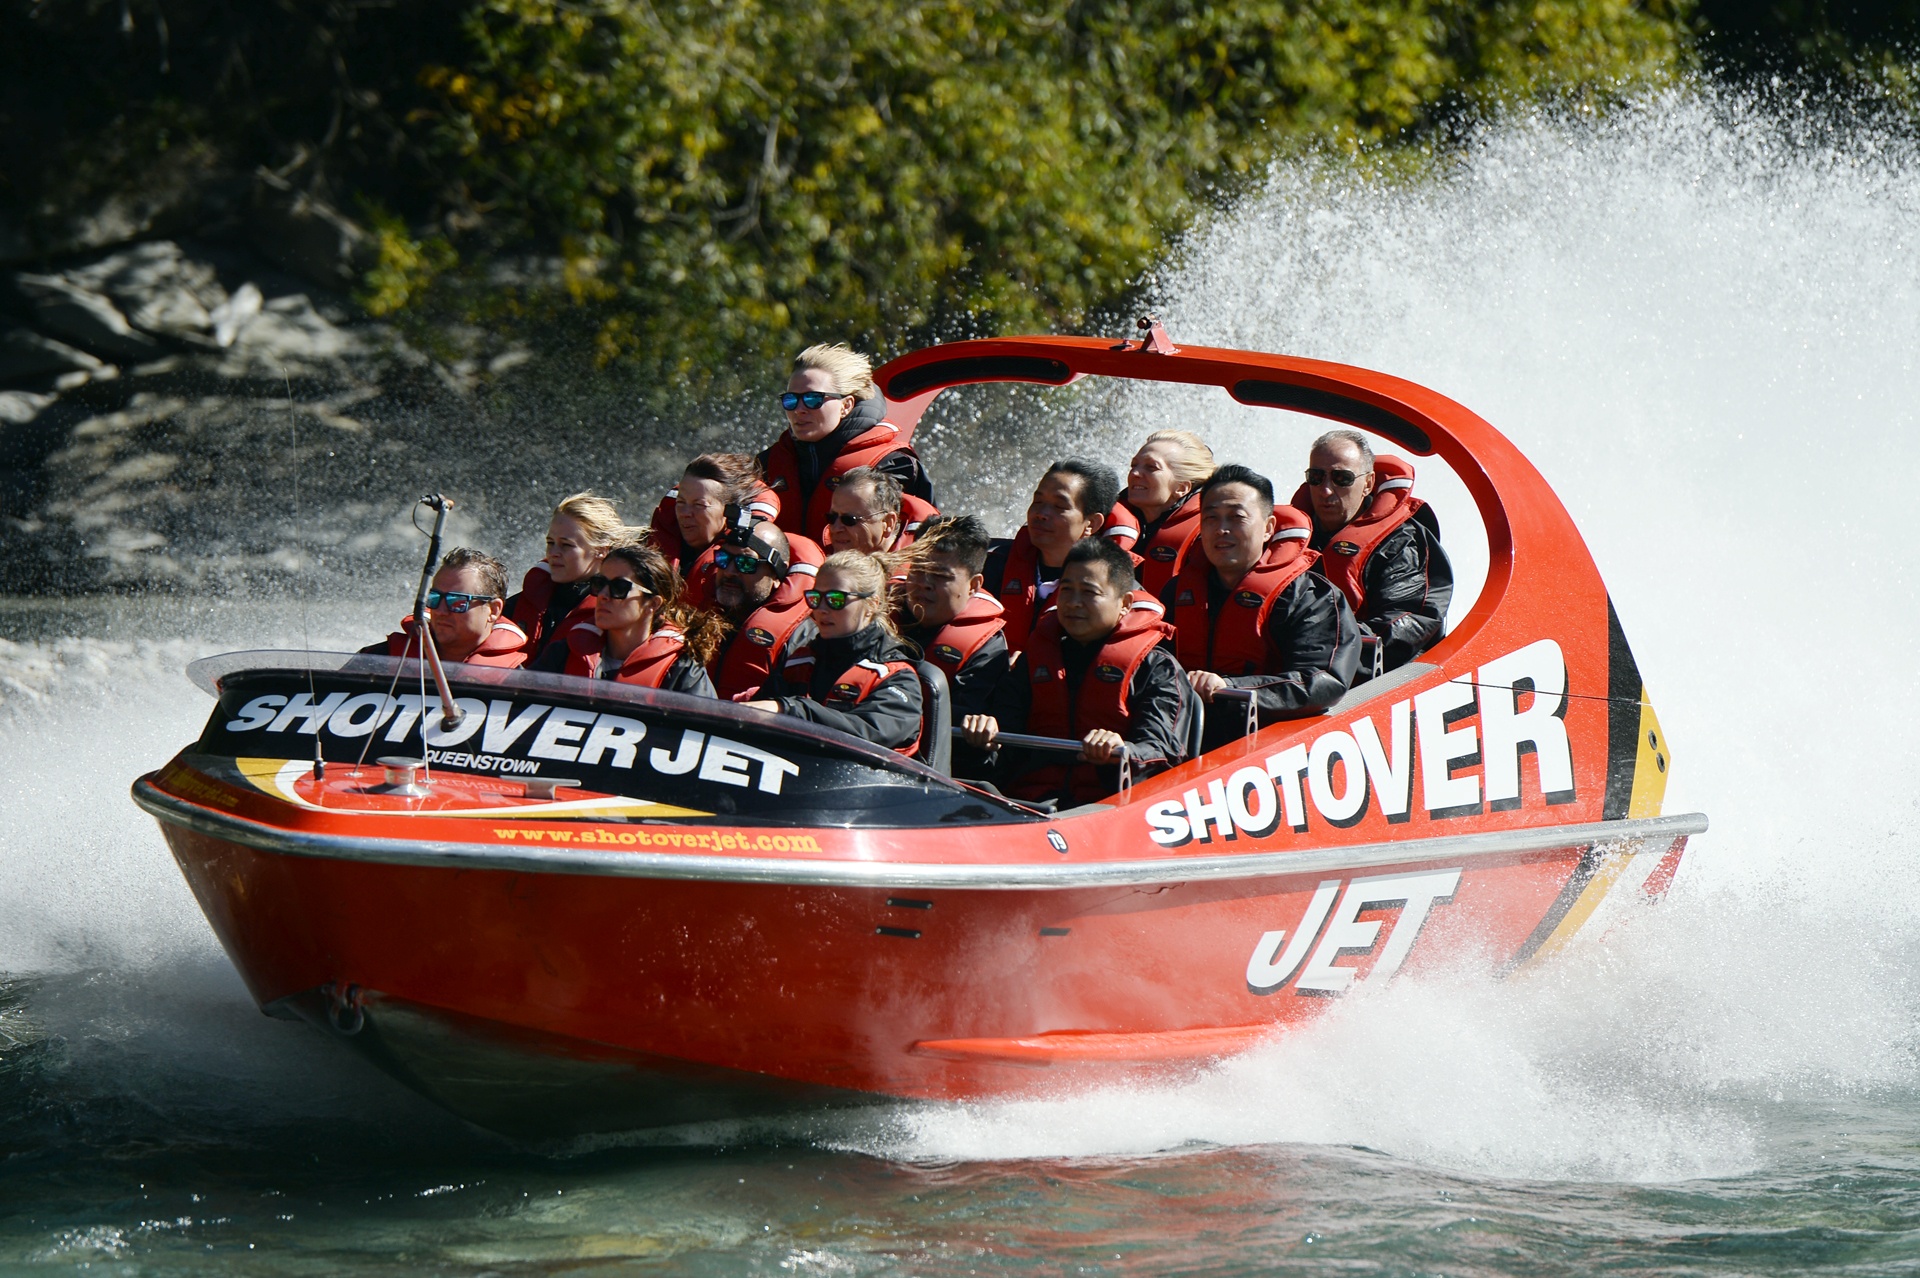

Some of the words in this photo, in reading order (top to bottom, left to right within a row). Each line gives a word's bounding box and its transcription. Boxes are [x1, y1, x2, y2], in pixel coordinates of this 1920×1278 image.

[226, 692, 647, 769] SHOTOVER
[650, 729, 800, 795] JET
[423, 749, 541, 775] QUEENSTOWN
[1144, 638, 1578, 848] SHOTOVER
[493, 827, 823, 853] www.shotoverjet.com
[1246, 866, 1463, 996] JET
